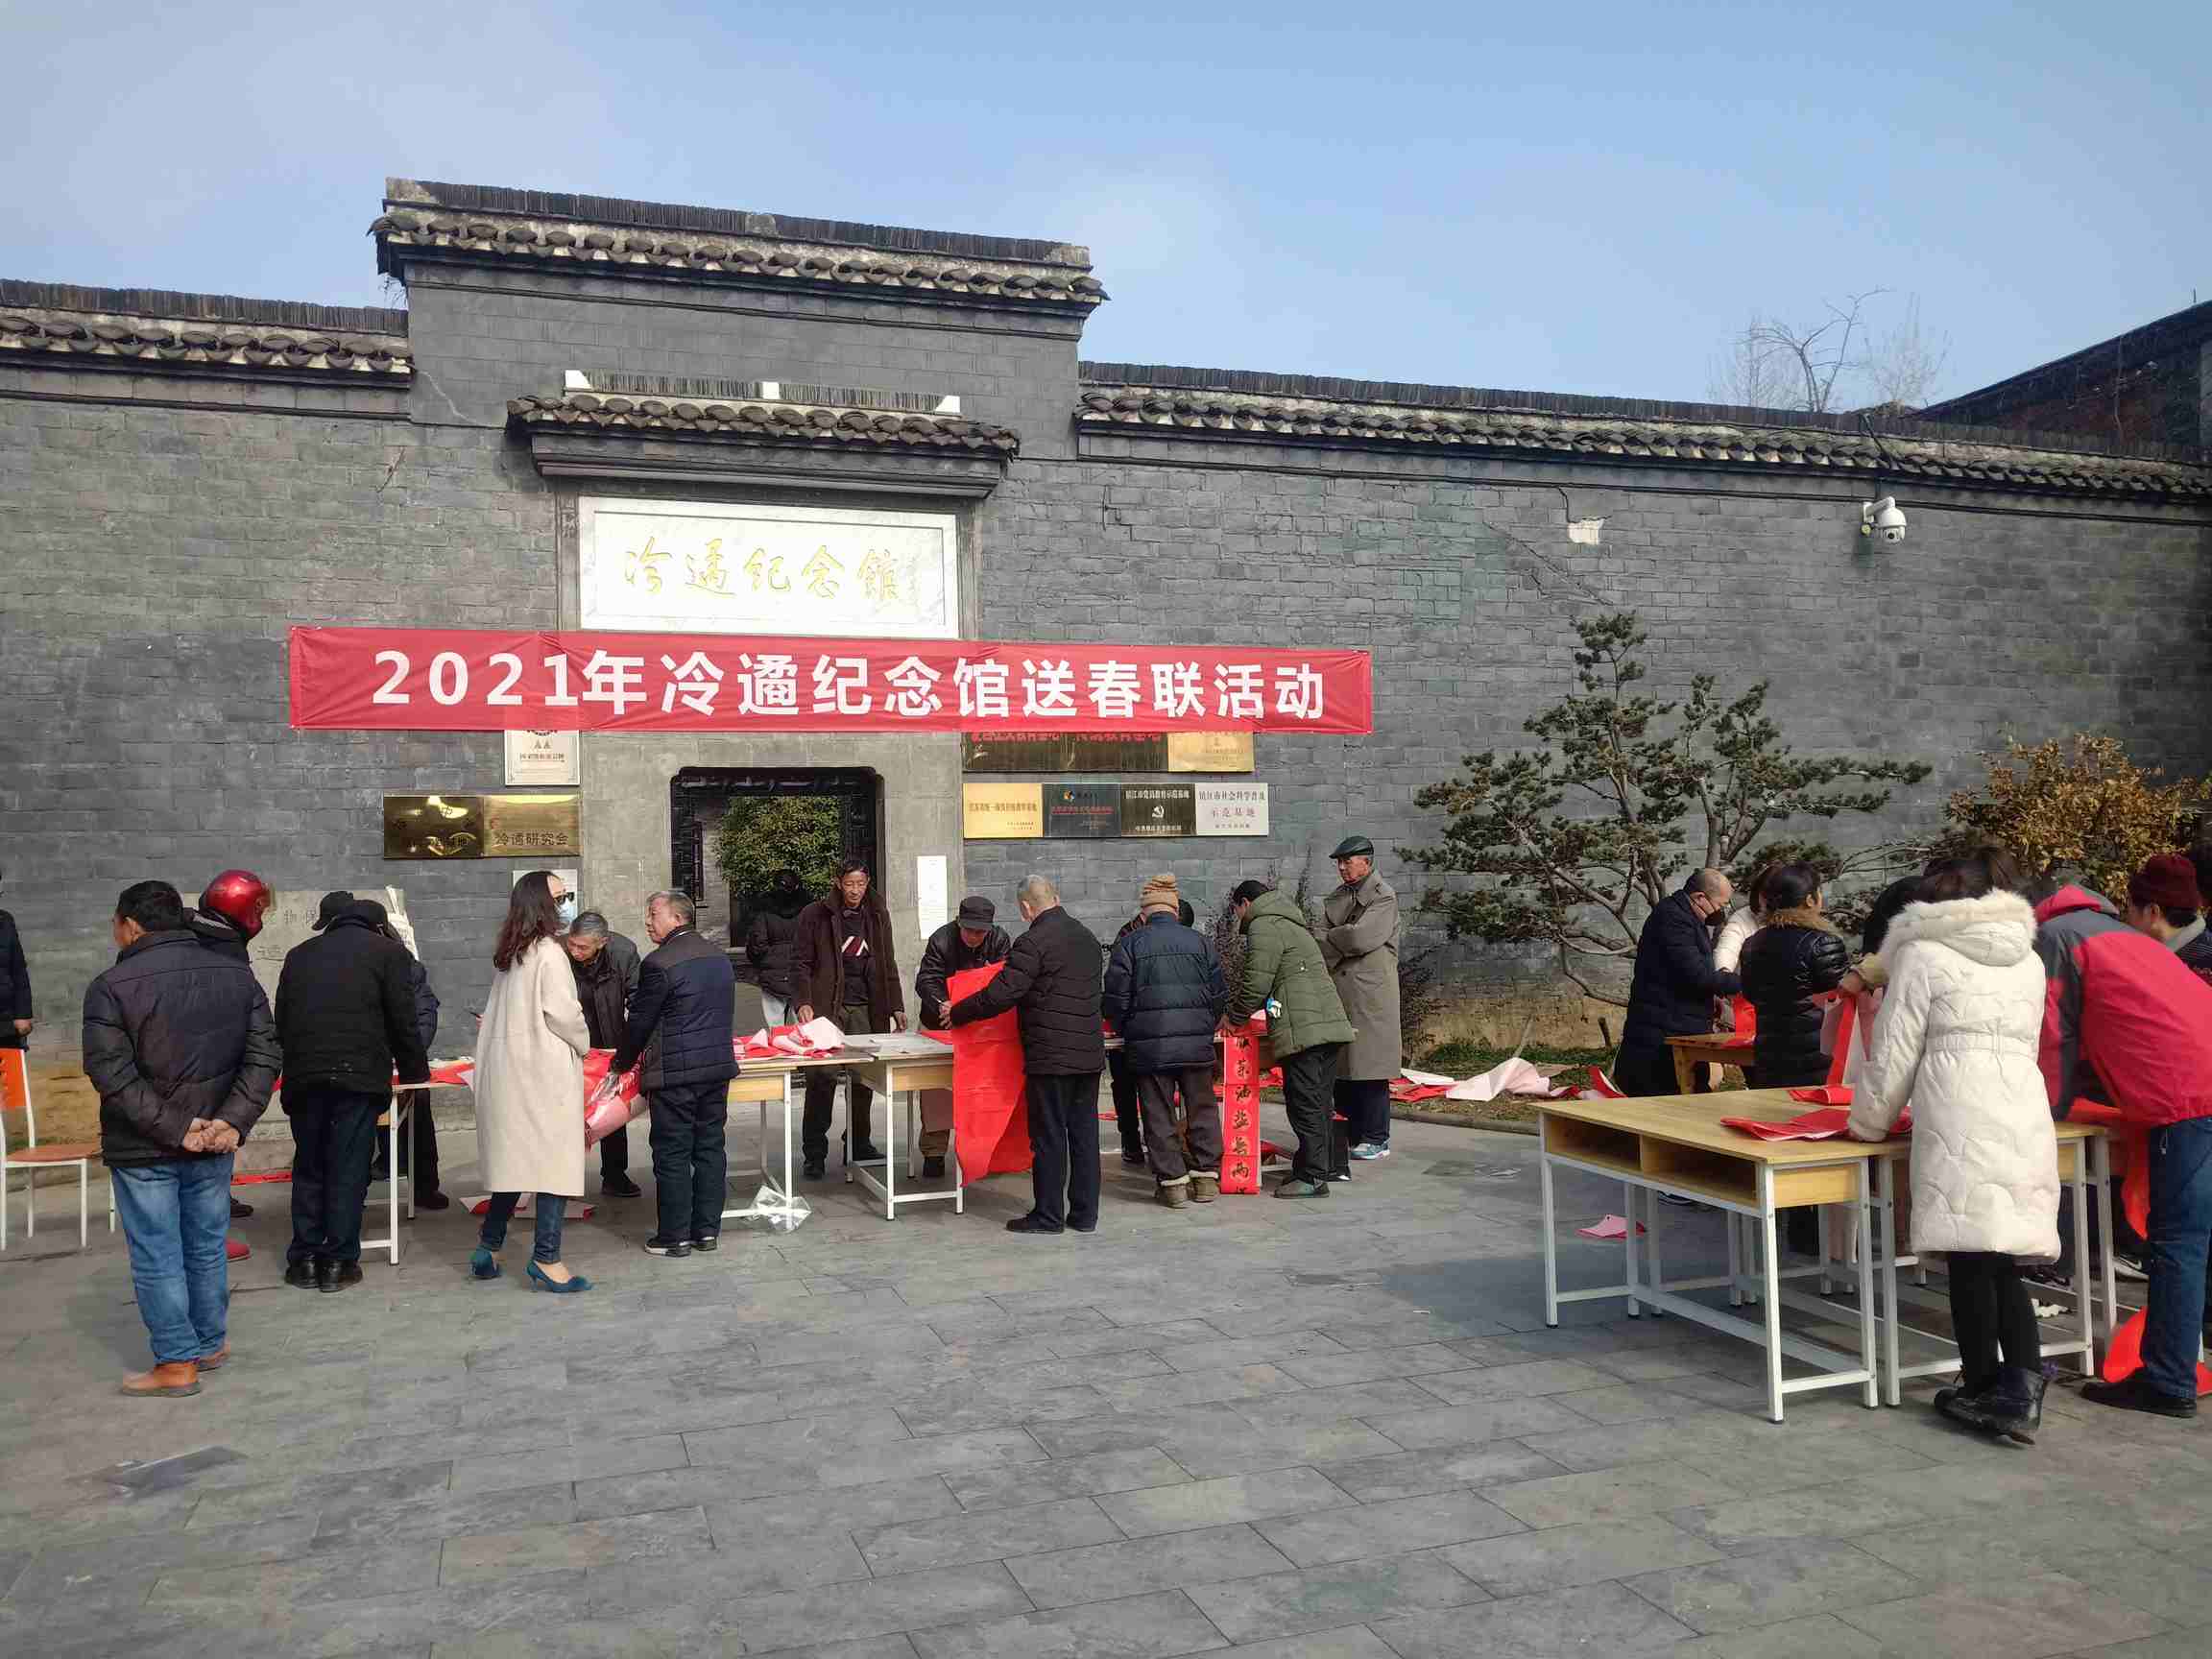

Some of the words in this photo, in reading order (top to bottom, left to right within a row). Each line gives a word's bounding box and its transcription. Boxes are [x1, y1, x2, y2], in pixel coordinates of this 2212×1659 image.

[372, 650, 1325, 720] 2021年冷遹纪念馆送春联活动
